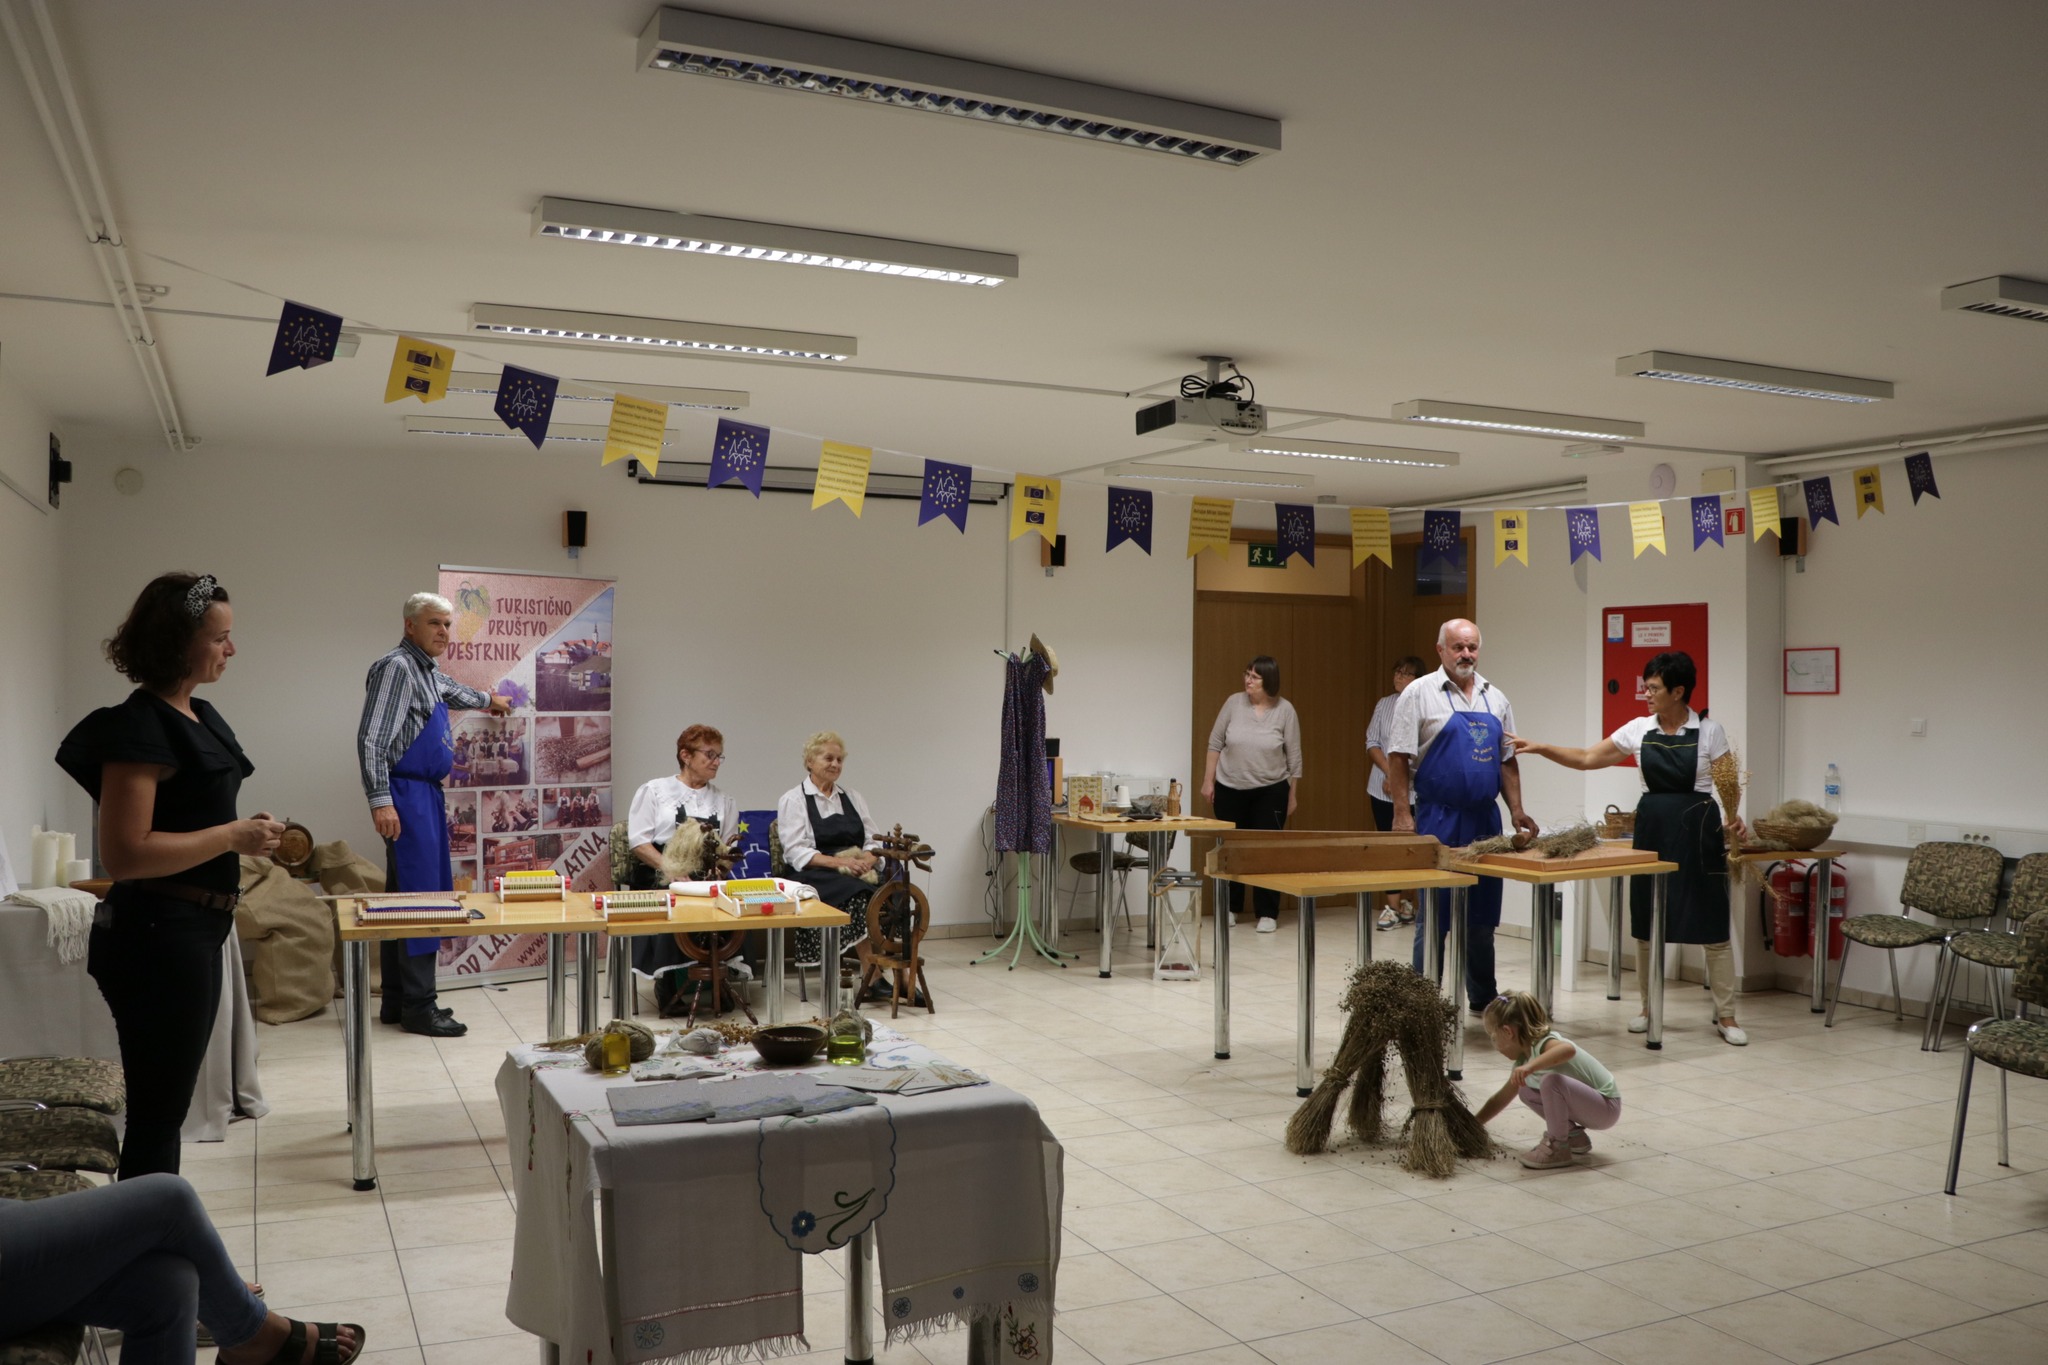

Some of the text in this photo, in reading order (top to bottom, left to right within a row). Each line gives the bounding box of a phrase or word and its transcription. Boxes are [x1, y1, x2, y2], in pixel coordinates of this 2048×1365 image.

[497, 596, 572, 616] TURISTIČNO
[488, 616, 547, 637] DRUŠTVO
[447, 642, 521, 661] DESTRNIK
[555, 831, 608, 879] ATNA
